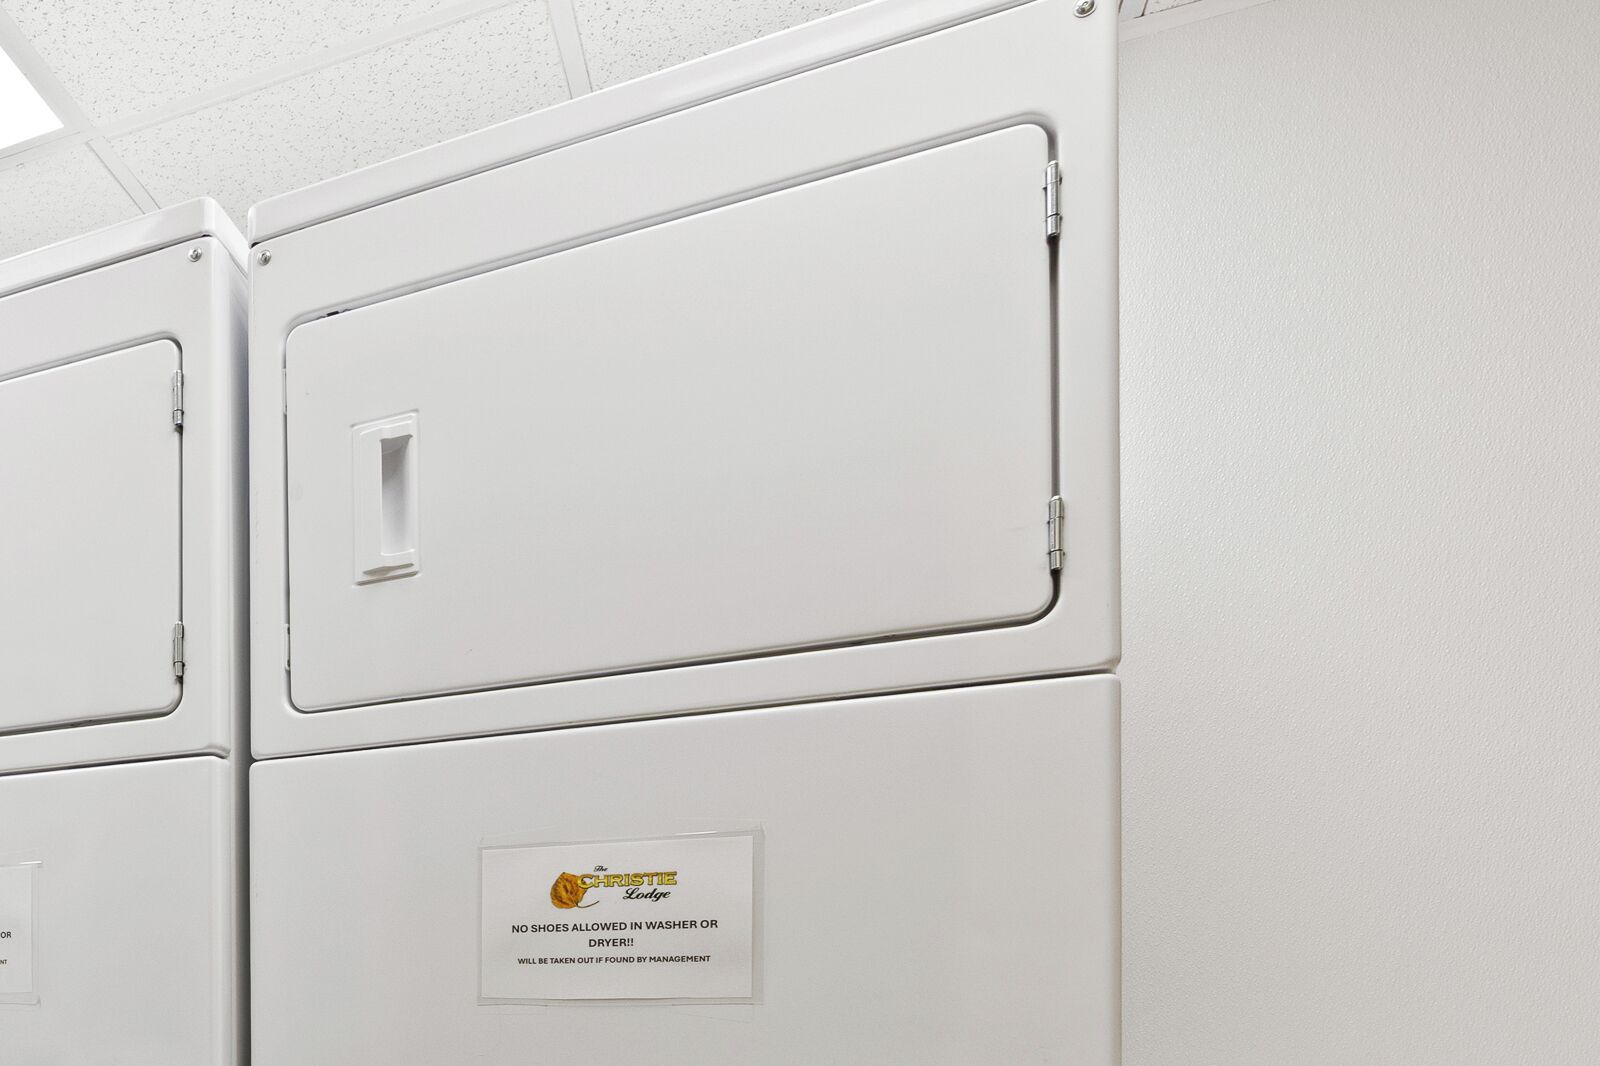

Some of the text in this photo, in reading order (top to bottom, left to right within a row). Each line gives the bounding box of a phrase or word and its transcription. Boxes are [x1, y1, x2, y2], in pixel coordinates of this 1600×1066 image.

[578, 871, 677, 889] CHRISTIE
[622, 887, 671, 902] Lodge
[512, 920, 718, 933] NO SHOES ALLOWED IN WASHER OR
[589, 938, 634, 947] DRYER!!
